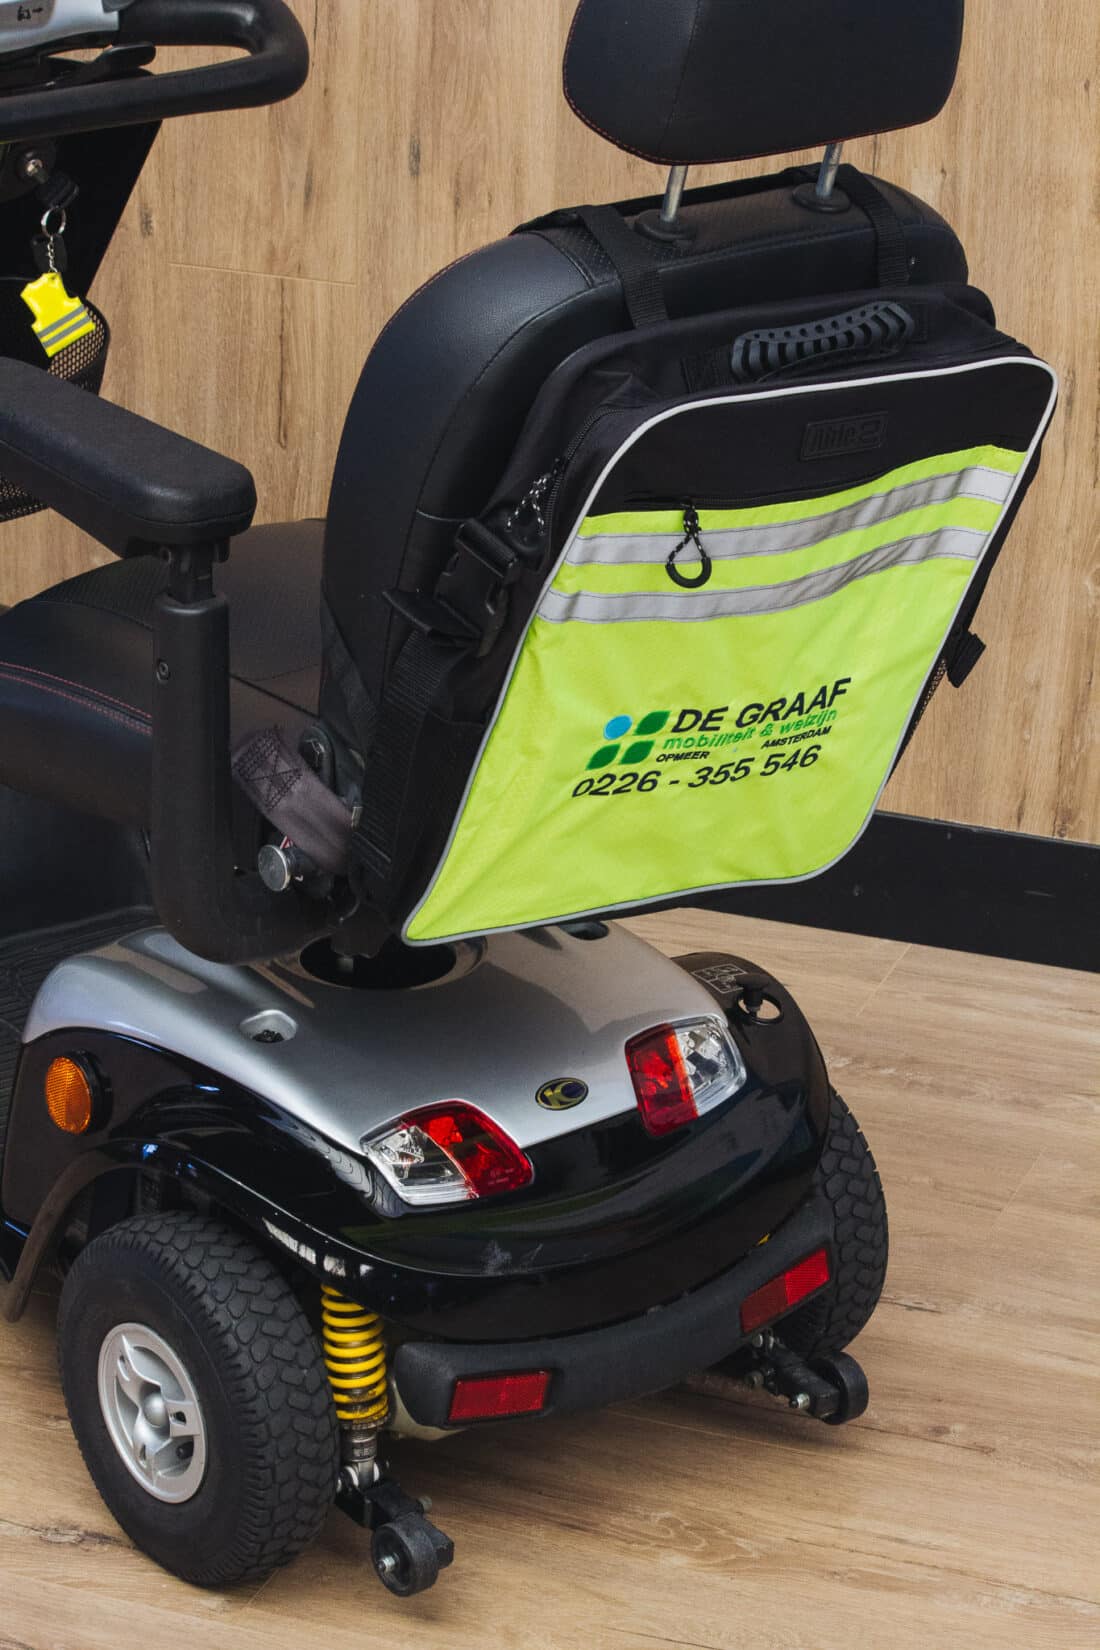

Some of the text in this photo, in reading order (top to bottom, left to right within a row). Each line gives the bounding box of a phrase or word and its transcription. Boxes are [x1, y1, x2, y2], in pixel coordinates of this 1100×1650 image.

[662, 708, 838, 750] mobiliteit & welzijn
[671, 677, 852, 733] DE GRAAF
[656, 725, 833, 763] OPMEER AMSTERDAM
[572, 770, 662, 798] 0226
[687, 757, 756, 788] 355
[760, 744, 823, 777] 546
